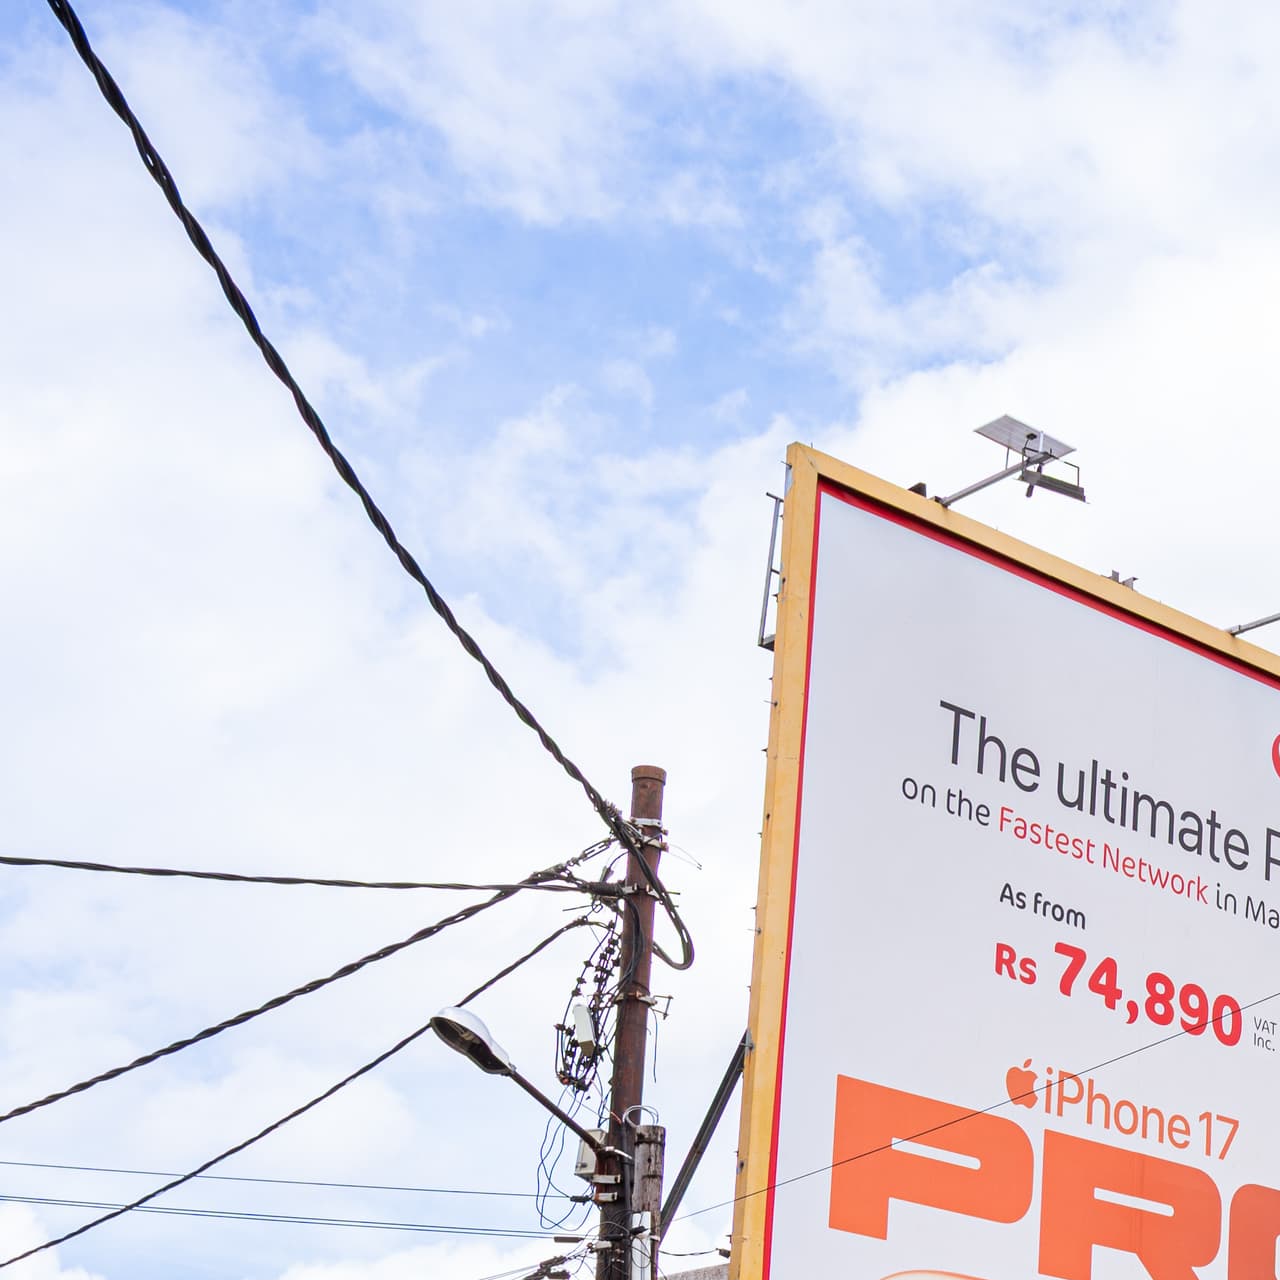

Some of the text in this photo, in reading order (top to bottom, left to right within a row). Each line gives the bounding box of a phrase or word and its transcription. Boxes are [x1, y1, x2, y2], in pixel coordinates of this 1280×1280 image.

[940, 700, 1041, 793] The
[1057, 759, 1250, 871] ultimate
[901, 776, 937, 808] on
[946, 789, 991, 827] the
[999, 806, 1096, 865] Fastest
[1103, 843, 1209, 905] Network
[1215, 883, 1238, 915] in
[999, 882, 1087, 930] As from
[994, 942, 1243, 1047] Rs 74,890
[1253, 1016, 1278, 1036] VAT
[1253, 1034, 1277, 1053] Inc.
[1045, 1067, 1240, 1160] iPhone 17
